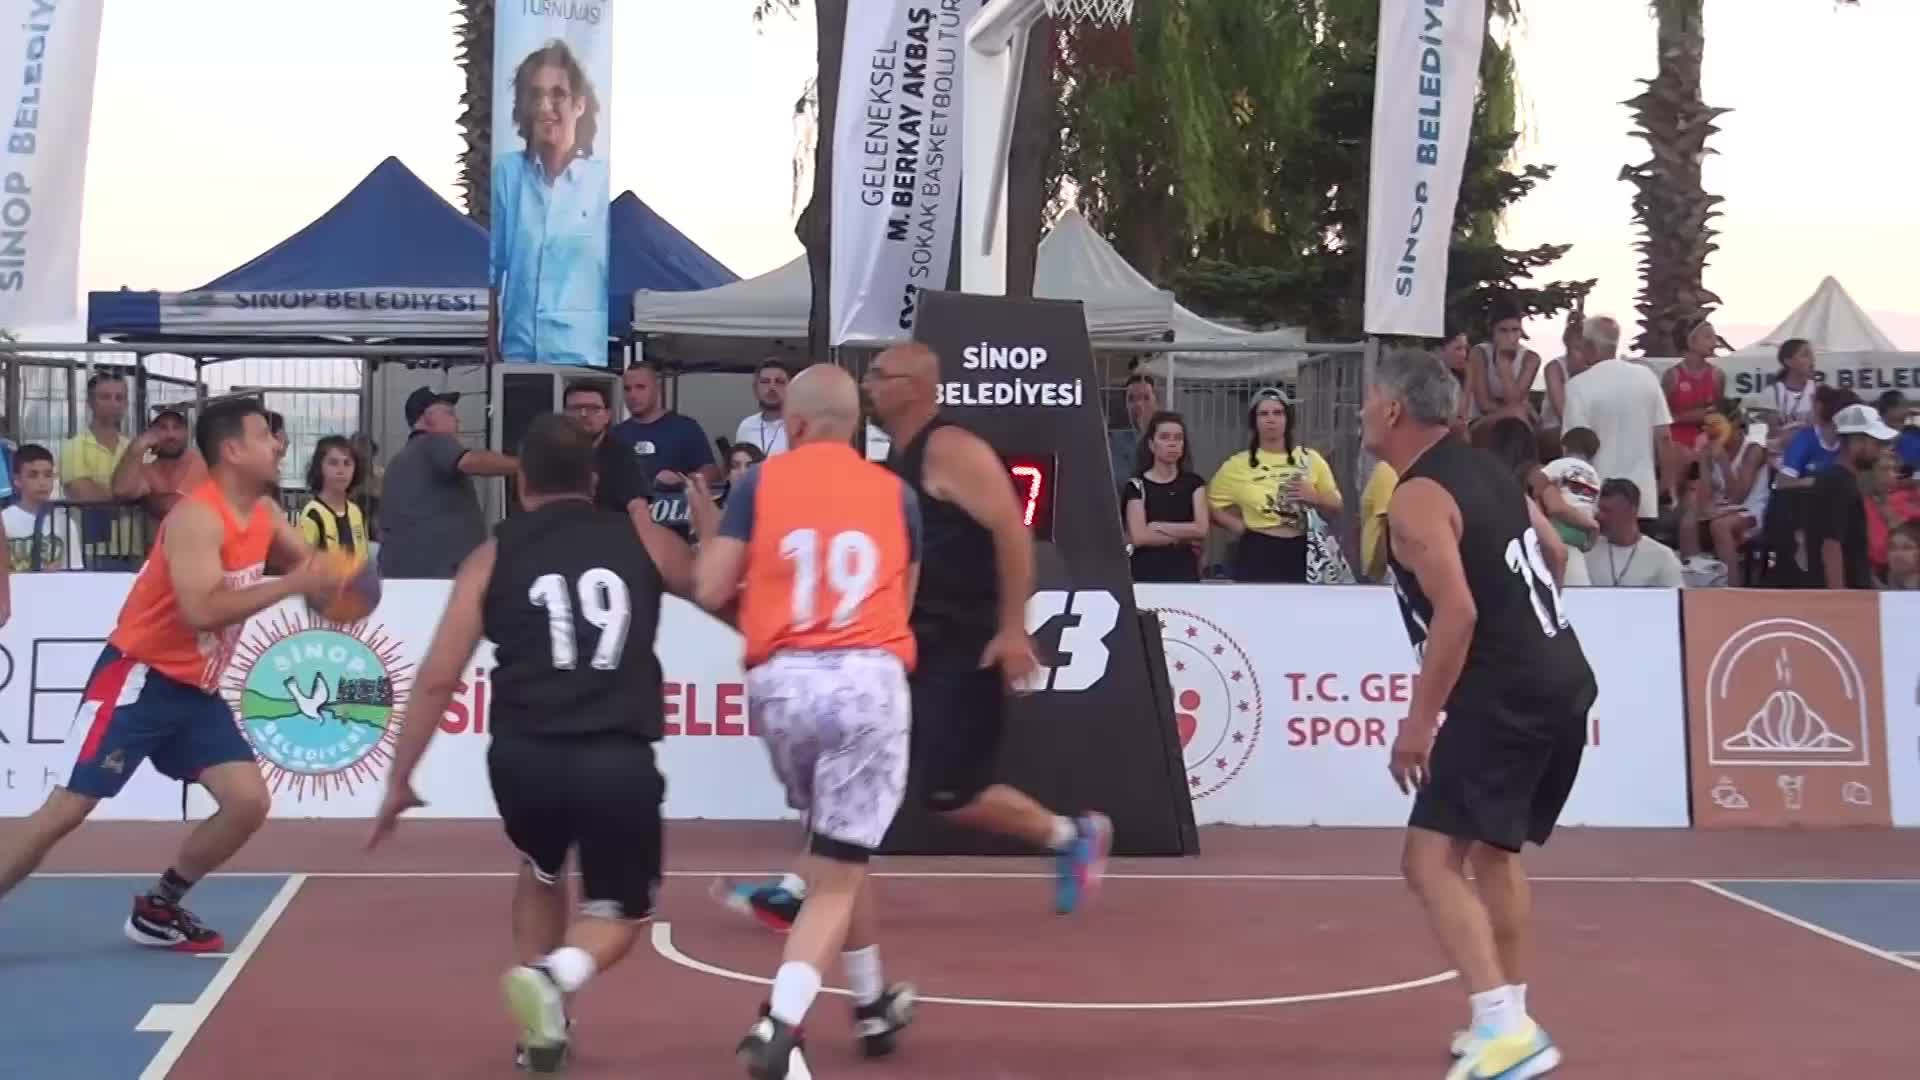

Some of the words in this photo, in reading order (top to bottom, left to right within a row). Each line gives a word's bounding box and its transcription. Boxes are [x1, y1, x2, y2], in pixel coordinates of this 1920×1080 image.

[901, 7, 938, 99] AKBAŞ
[861, 40, 897, 207] GELENEKSEL
[891, 103, 923, 208] BERKAY
[922, 48, 957, 197] BASKETBOLU
[887, 213, 911, 241] M.
[909, 203, 939, 279] SOKAK
[962, 342, 1048, 369] SİNOP
[528, 567, 632, 670] 19
[777, 527, 881, 633] 19
[1284, 673, 1350, 702] T.C.
[1287, 717, 1386, 747] SPOR
